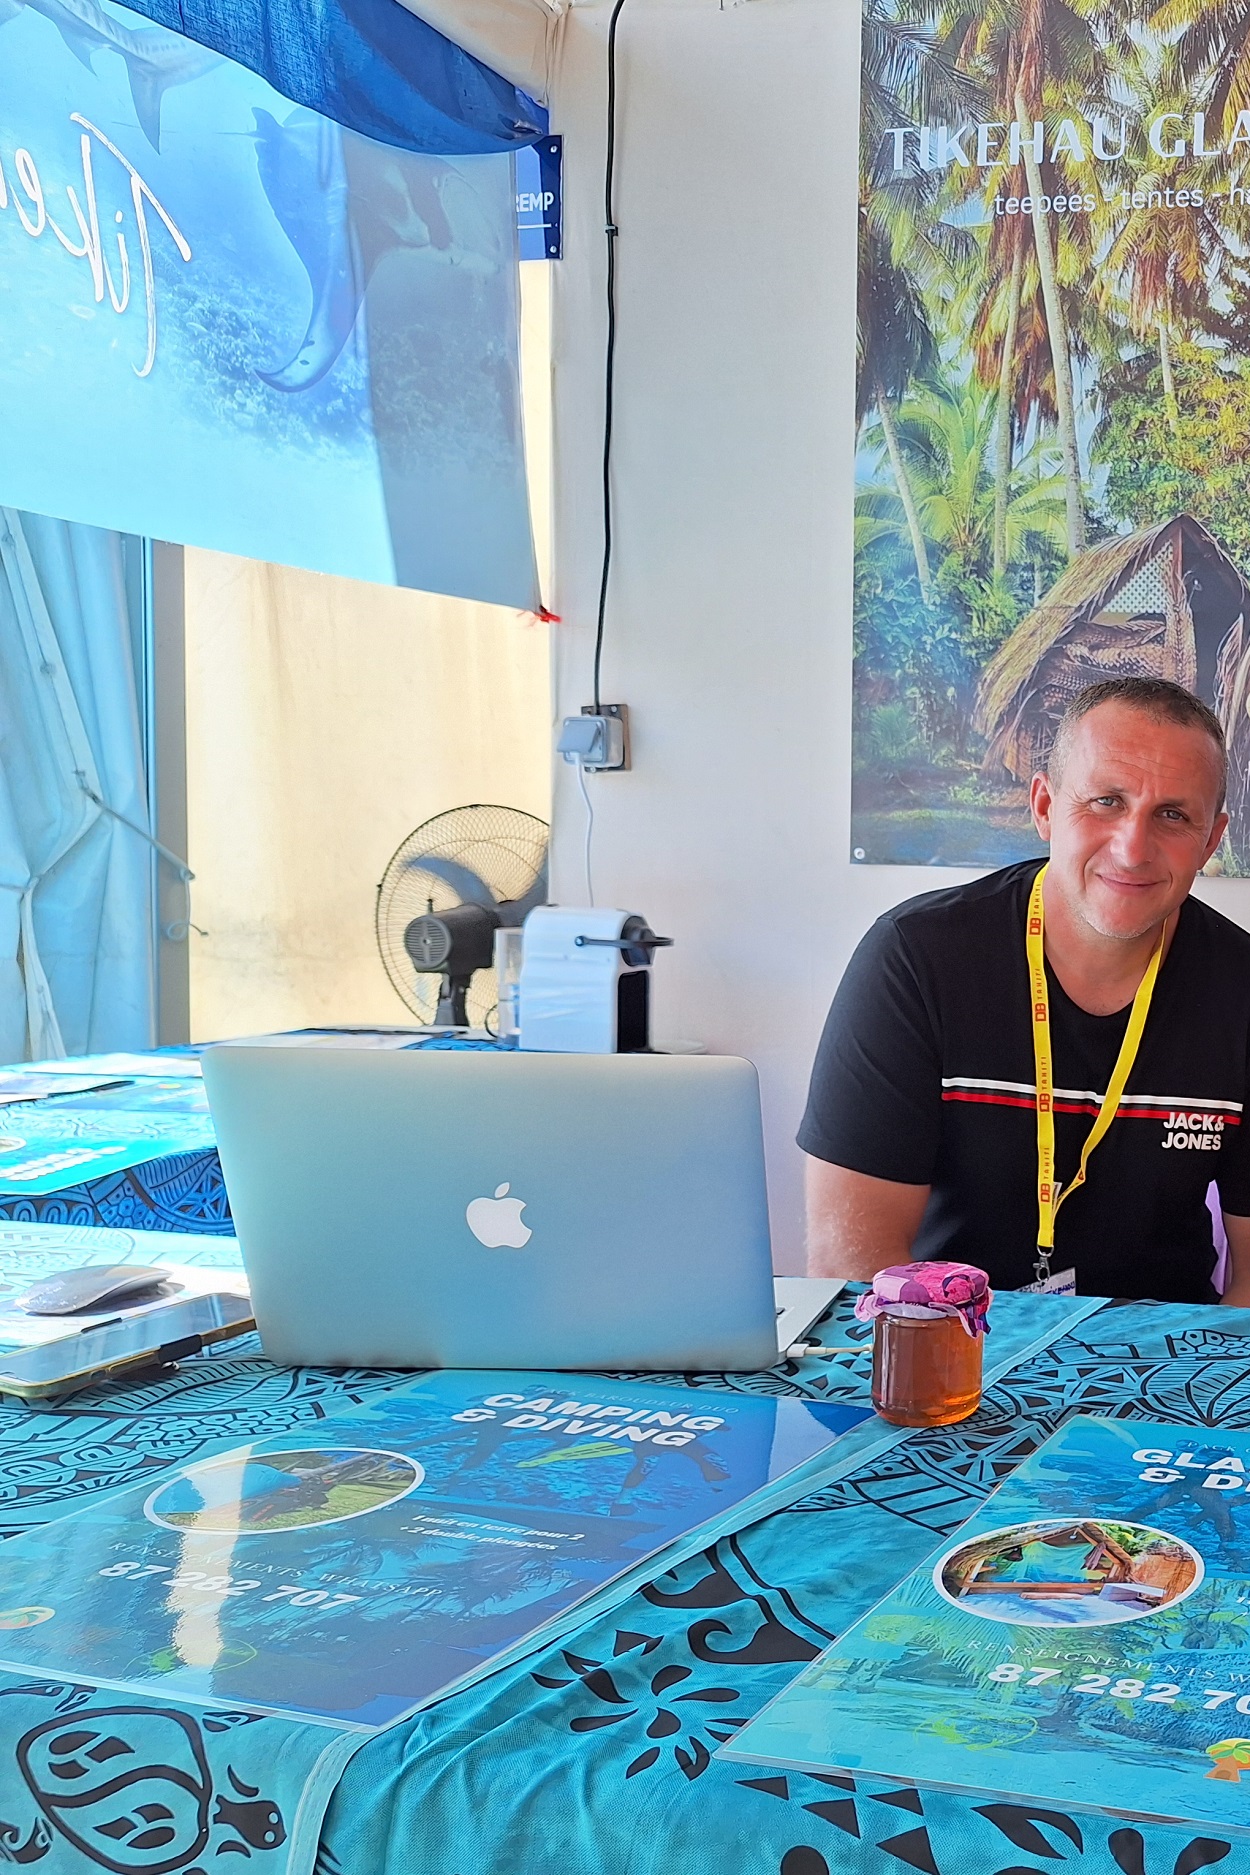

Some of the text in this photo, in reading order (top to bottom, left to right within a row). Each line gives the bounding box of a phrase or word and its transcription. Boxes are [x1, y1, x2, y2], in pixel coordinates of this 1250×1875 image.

[884, 115, 1126, 171] TIKEHAU
[516, 191, 555, 213] EMP
[994, 191, 1096, 216] teepees
[1121, 187, 1204, 209] tentes
[1033, 884, 1041, 915] TAHITI
[1035, 968, 1043, 1000] TAHITI
[1161, 1132, 1222, 1151] JONES
[483, 1393, 726, 1432] CAMPING
[699, 1405, 740, 1414] DUO
[450, 1408, 697, 1447] & DIVING
[1186, 1441, 1237, 1452] PACK
[1138, 1467, 1186, 1484] &
[422, 1528, 480, 1541] double
[477, 1537, 559, 1550] plongées
[480, 1523, 527, 1534] tente
[526, 1529, 569, 1540] pour
[568, 1533, 585, 1541] 2
[98, 1561, 363, 1611] 87 282 707
[319, 1573, 443, 1597] WHATSAPP
[967, 1640, 1216, 1679] RENSEIGNEMENTS
[988, 1663, 1062, 1686] 87
[1073, 1673, 1182, 1704] 282
